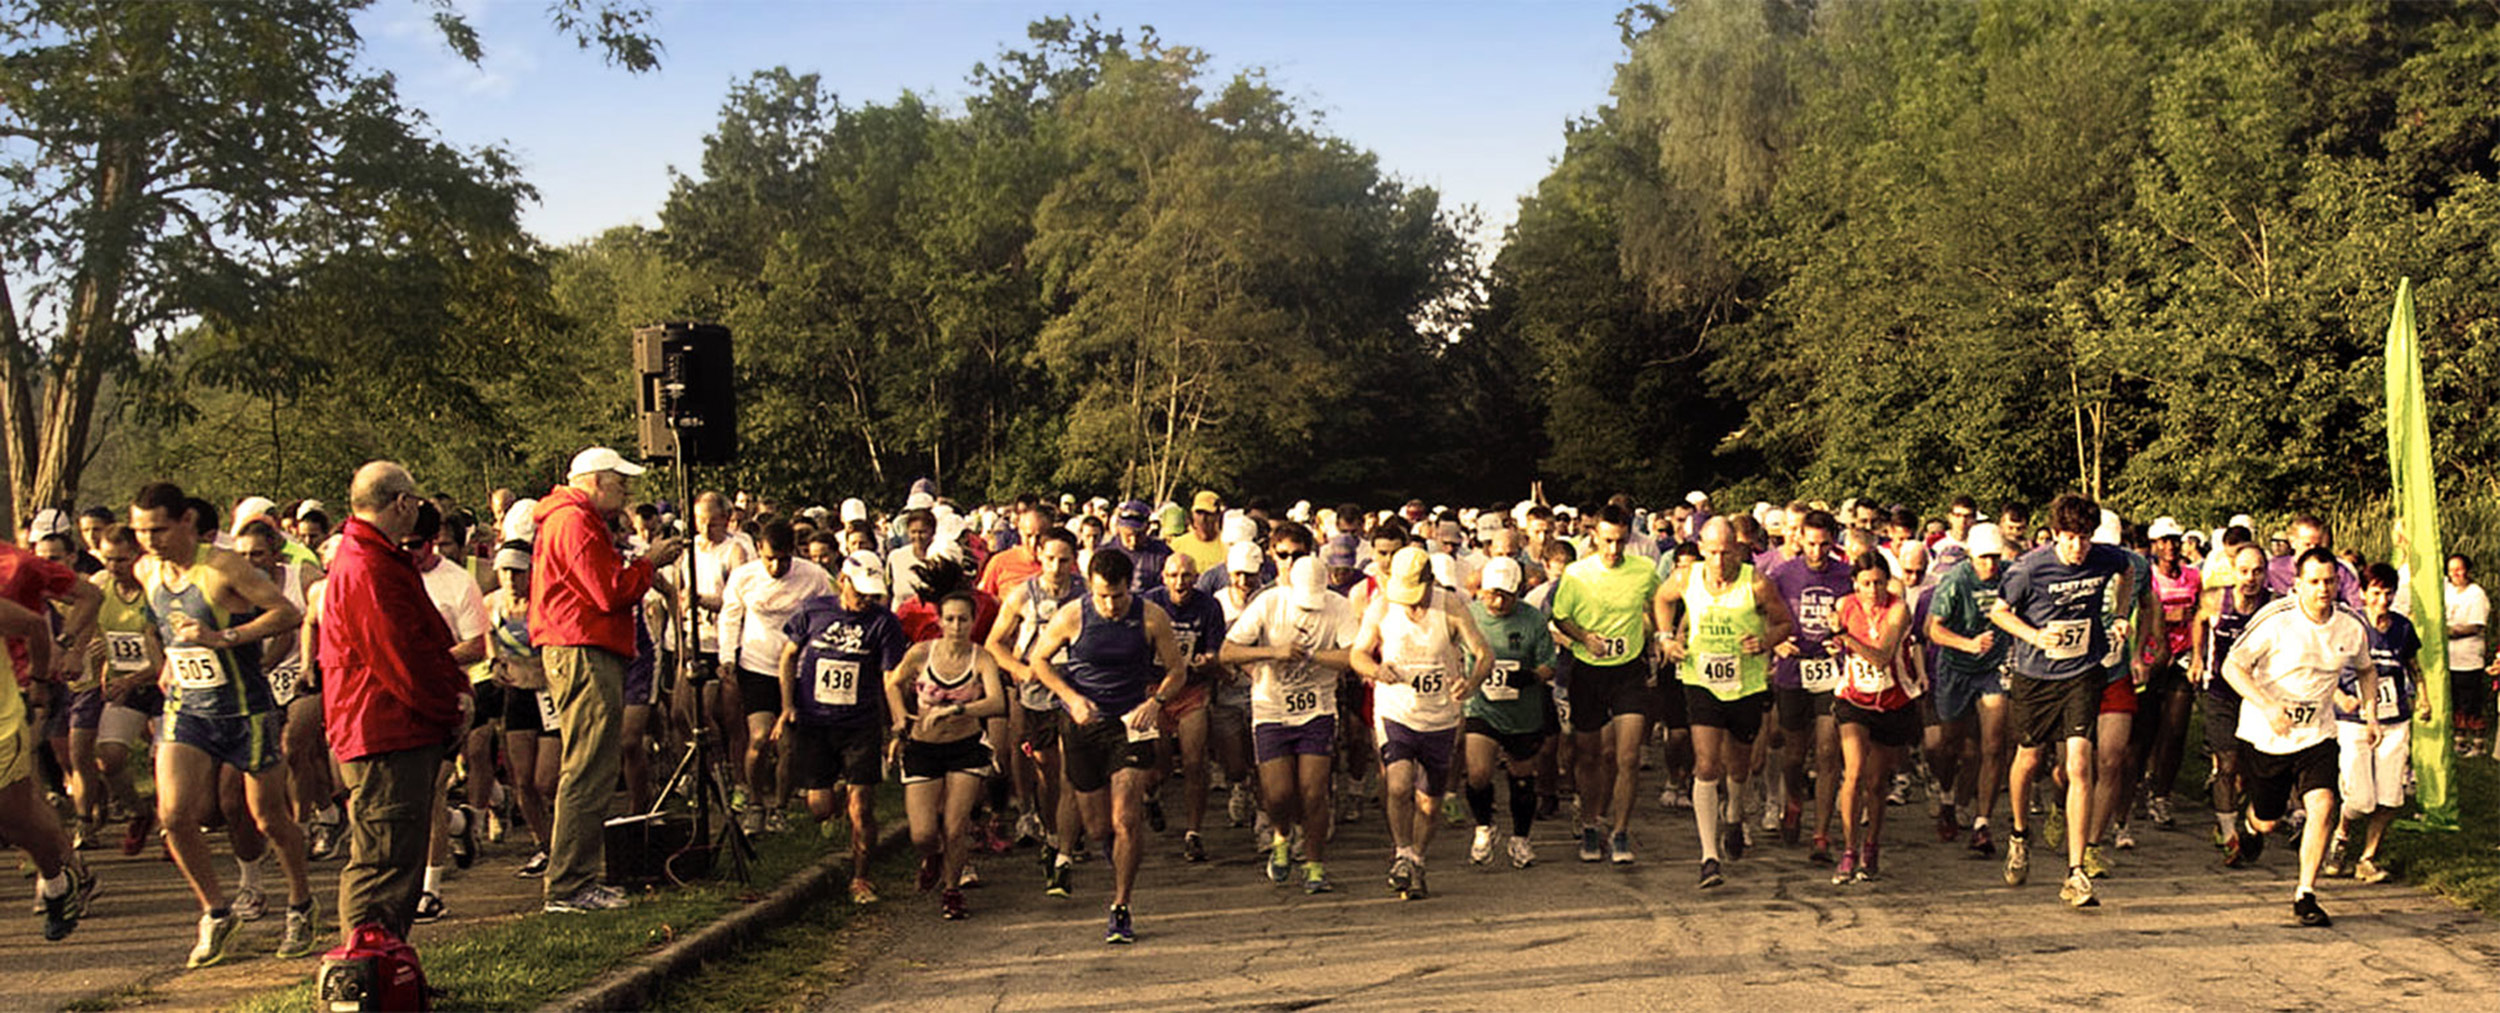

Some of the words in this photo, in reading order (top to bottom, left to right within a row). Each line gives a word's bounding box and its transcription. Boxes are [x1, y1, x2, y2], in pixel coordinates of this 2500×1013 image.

[1605, 638, 1625, 656] 78
[1705, 662, 1735, 679] 406
[1805, 662, 1832, 680] 653
[822, 670, 853, 690] 438
[1412, 674, 1442, 693] 465
[1285, 691, 1316, 712] 569
